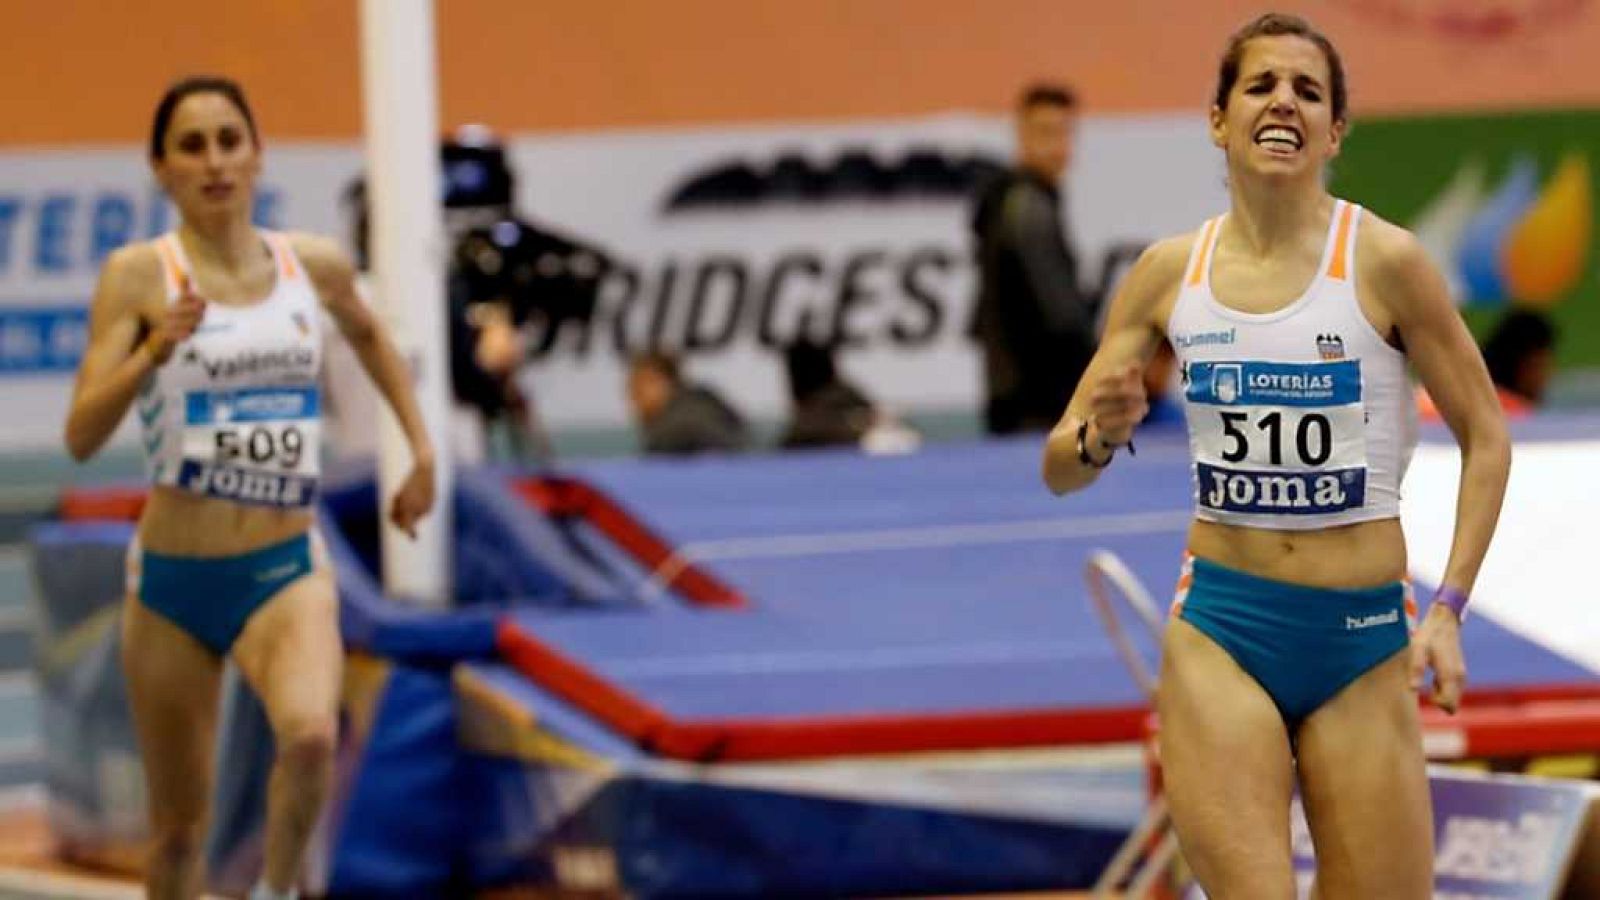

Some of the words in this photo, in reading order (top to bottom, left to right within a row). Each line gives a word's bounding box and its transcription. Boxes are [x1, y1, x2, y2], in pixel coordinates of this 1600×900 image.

[1249, 372, 1334, 390] LOTERÍAS
[214, 425, 303, 469] 509
[1219, 411, 1332, 467] 510
